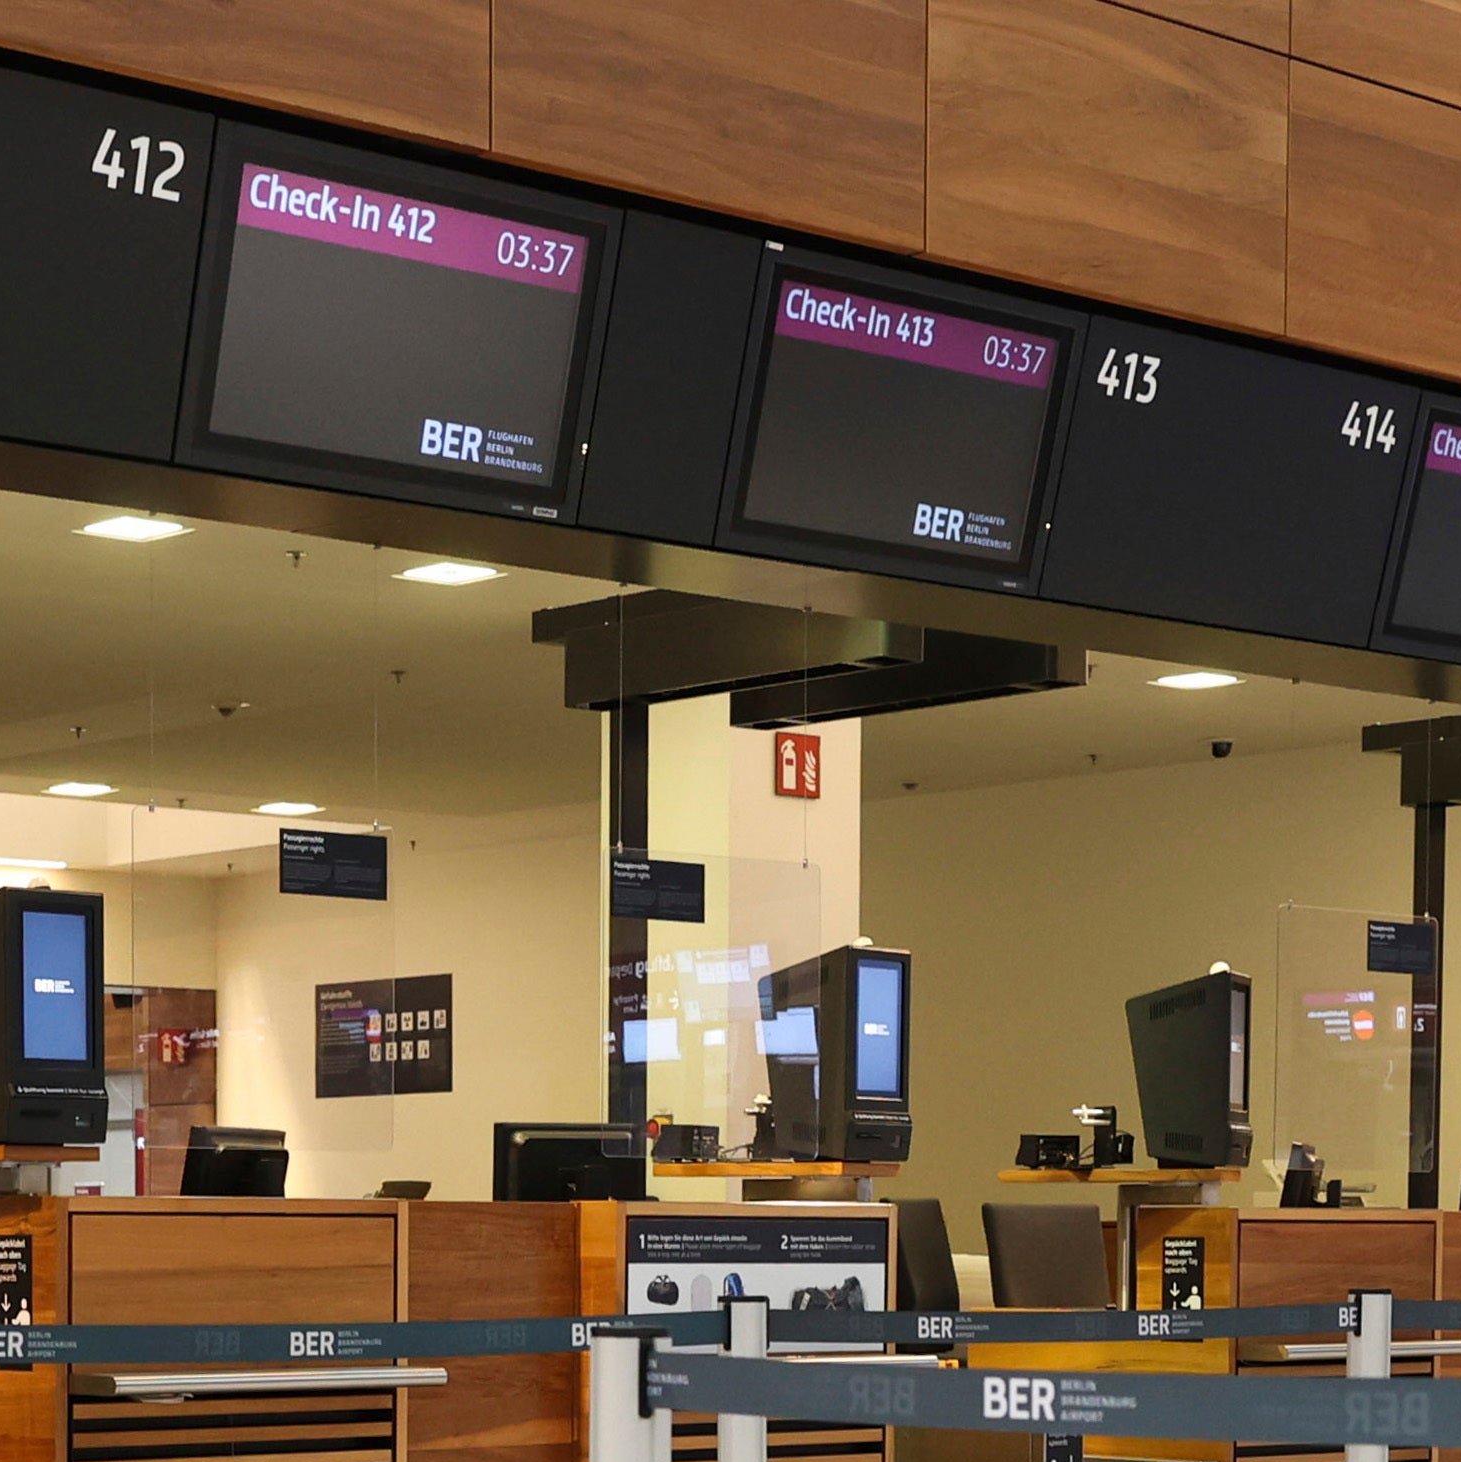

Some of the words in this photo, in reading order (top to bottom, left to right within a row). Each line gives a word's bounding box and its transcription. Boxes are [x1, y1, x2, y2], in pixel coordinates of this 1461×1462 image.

[91, 128, 185, 202] 412
[249, 173, 381, 233] Check-In
[387, 203, 436, 244] 412
[497, 231, 575, 277] 03:37
[785, 288, 890, 338] Check-In
[896, 312, 935, 347] 413
[983, 335, 1046, 374] 03:37
[1097, 348, 1161, 404] 413
[488, 430, 534, 446] FLUGHAFEN
[1341, 401, 1396, 454] 414
[420, 418, 483, 463] BER
[486, 442, 515, 456] BERLIN
[484, 456, 543, 474] BRANDENBURG
[913, 503, 964, 542] BER
[639, 1233, 645, 1249] 1
[781, 1234, 789, 1250] 2
[917, 1316, 953, 1339] BER
[1138, 1314, 1171, 1336] BER
[1338, 1306, 1358, 1327] BE
[290, 1331, 335, 1357] BER
[1061, 1379, 1096, 1391] BERLIN
[983, 1376, 1055, 1421] BER
[1061, 1395, 1137, 1409] BRANDENBURG
[1060, 1410, 1104, 1422] AIRPORT
